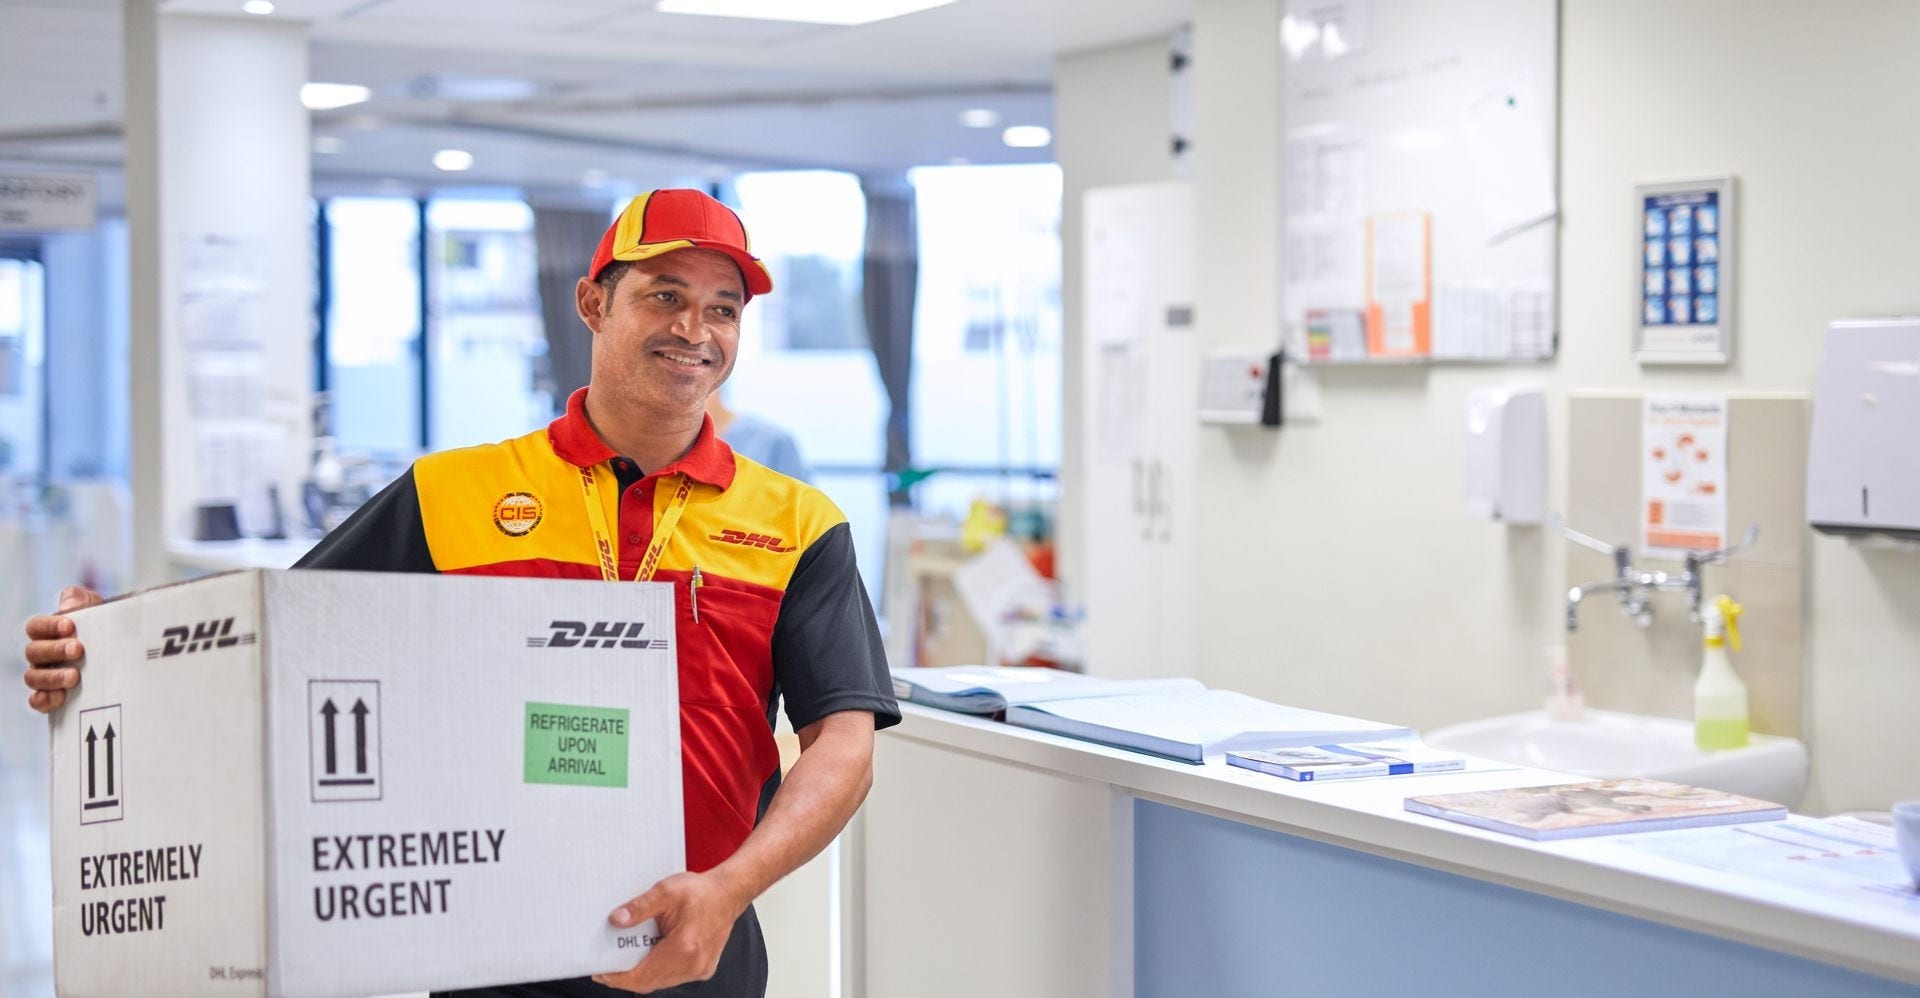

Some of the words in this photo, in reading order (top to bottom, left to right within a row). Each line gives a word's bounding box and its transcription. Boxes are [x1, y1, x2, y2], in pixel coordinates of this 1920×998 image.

[580, 466, 594, 488] HL
[500, 506, 536, 521] CIS
[720, 529, 786, 553] DHL
[161, 617, 239, 657] DHL
[547, 620, 651, 649] DHL
[530, 713, 625, 735] REFRIGERATE
[558, 737, 597, 754] UPON
[547, 757, 606, 775] ARRIVAL
[312, 829, 505, 872] EXTREMELY
[80, 843, 203, 890] EXTREMELY
[314, 879, 451, 922] URGENT
[81, 895, 166, 936] URGENT
[617, 936, 640, 949] DHL
